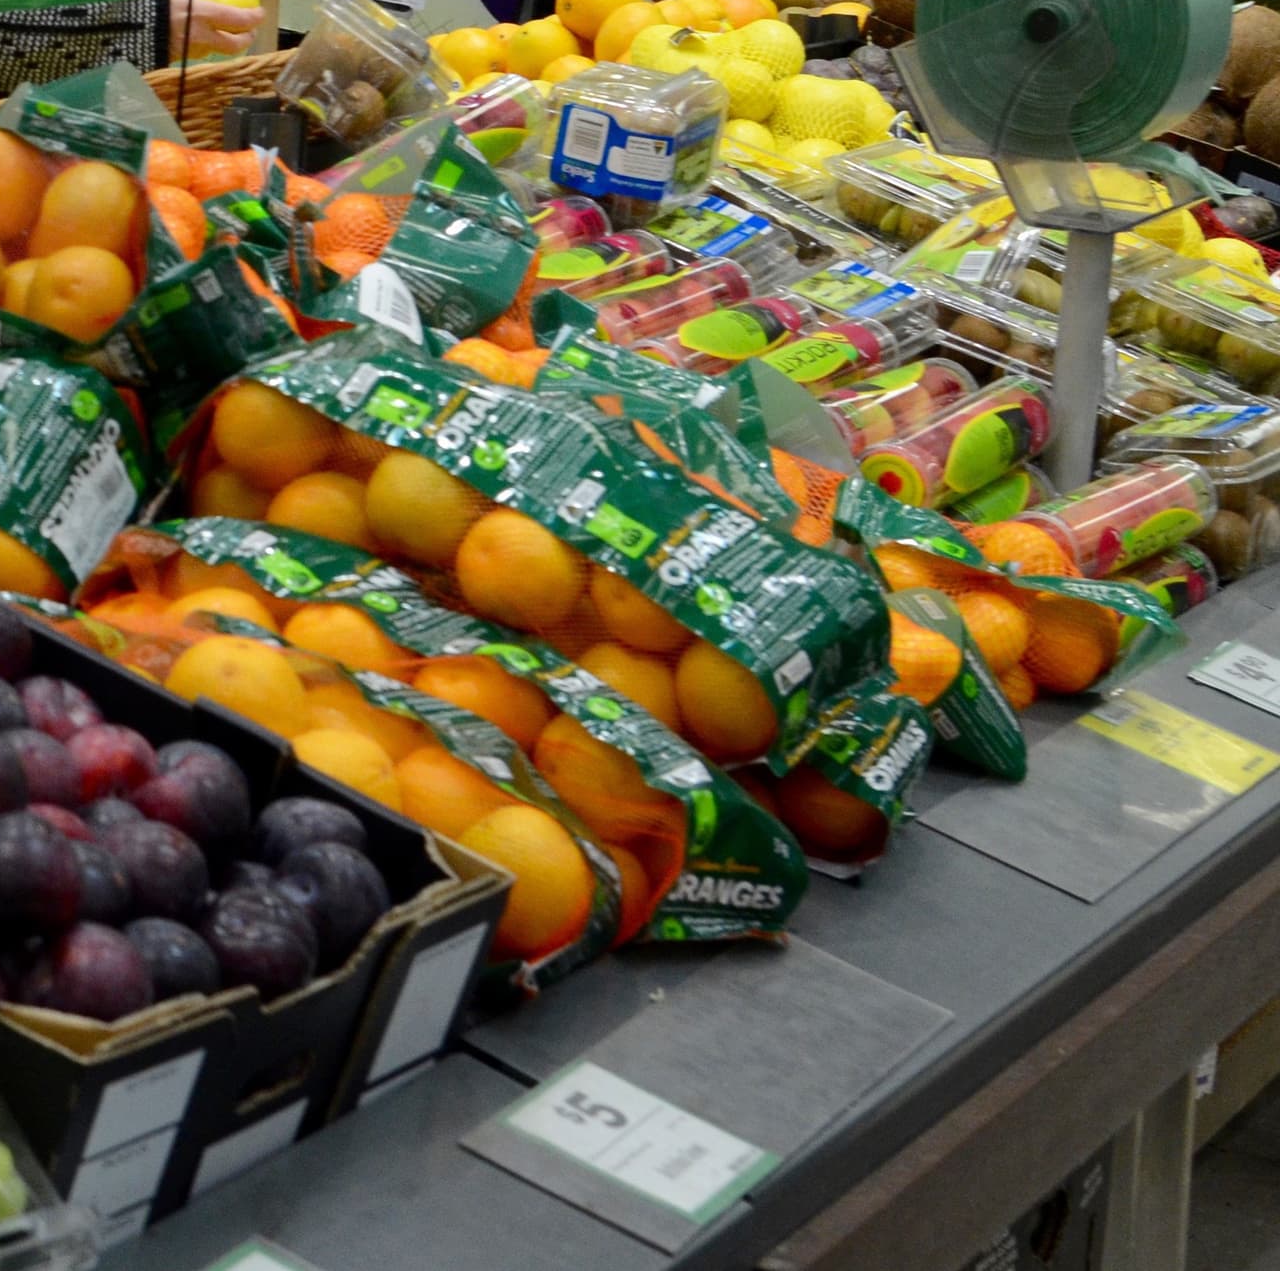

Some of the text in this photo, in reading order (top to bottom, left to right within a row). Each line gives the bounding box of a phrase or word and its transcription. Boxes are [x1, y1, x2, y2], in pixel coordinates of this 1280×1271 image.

[785, 340, 839, 375] ROCKIT
[669, 872, 785, 908] RANGES
[552, 1091, 628, 1129] $5
